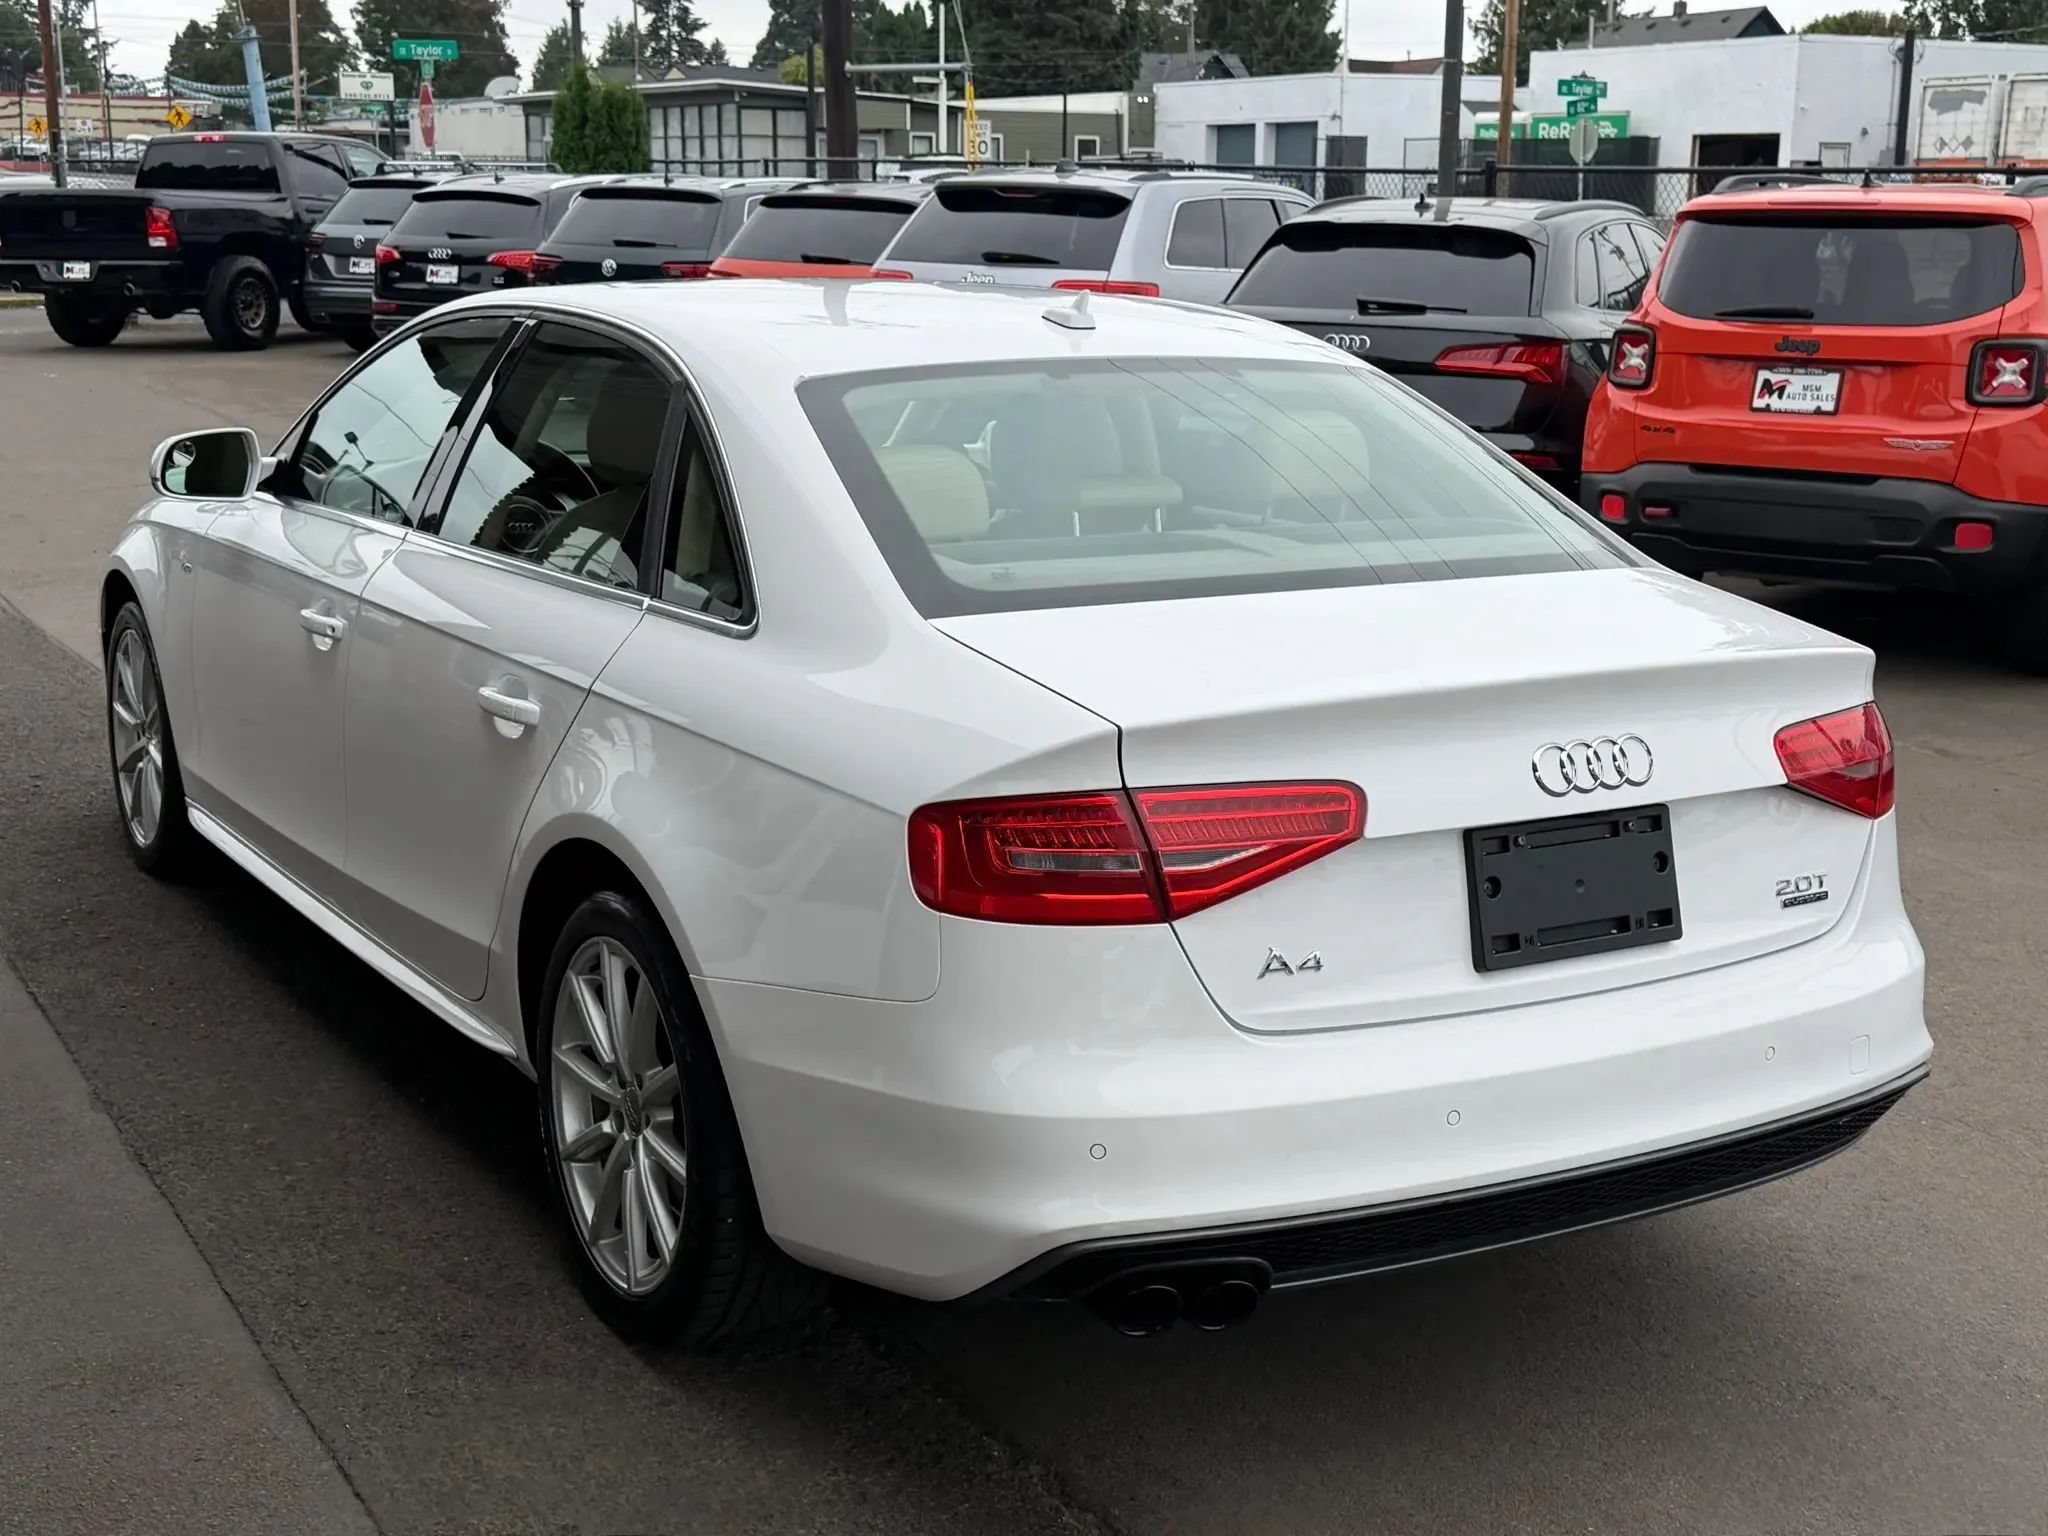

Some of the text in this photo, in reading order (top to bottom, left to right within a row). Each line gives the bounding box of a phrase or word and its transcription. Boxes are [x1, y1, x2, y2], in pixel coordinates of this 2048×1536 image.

[410, 44, 443, 58] Taylor
[1775, 336, 1820, 356] Jeep
[1786, 392, 1835, 403] AUTO SALES
[1257, 946, 1324, 980] A4
